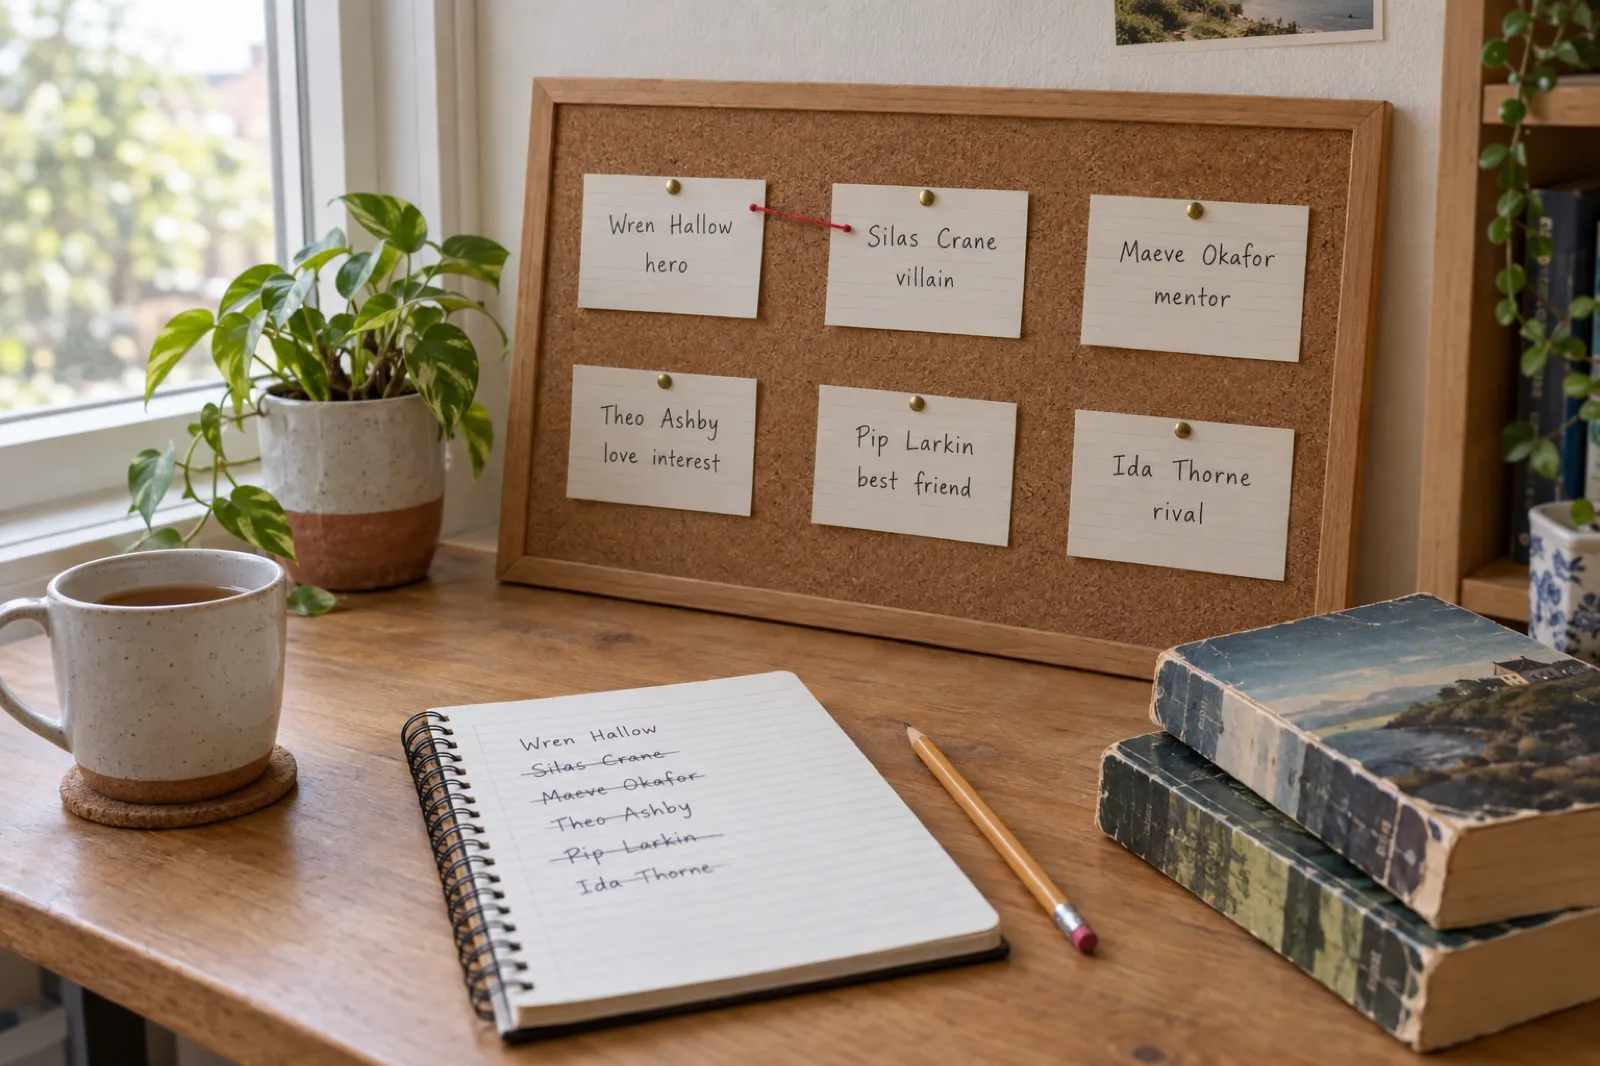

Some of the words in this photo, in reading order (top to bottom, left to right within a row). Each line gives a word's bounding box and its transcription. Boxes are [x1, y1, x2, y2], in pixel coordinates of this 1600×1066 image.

[608, 212, 655, 235] Wren
[669, 212, 733, 236] Hallow
[867, 224, 919, 248] Silas
[936, 227, 998, 251] Crane
[645, 251, 688, 274] hero
[1119, 239, 1185, 264] Maeve
[1202, 242, 1276, 269] Okafor
[896, 265, 954, 288] villain
[1154, 286, 1231, 308] mentor
[600, 403, 645, 426] Theo
[660, 407, 719, 442] Ashby
[855, 424, 889, 458] Pip
[906, 429, 974, 456] Larkin
[604, 442, 638, 464] love
[652, 449, 721, 473] interest
[1112, 454, 1153, 478] Ida
[1171, 458, 1252, 487] Thorne
[857, 465, 899, 491] best
[913, 470, 971, 499] friend
[1153, 501, 1204, 525] rival
[520, 736, 575, 752] Wren
[590, 725, 656, 742] Hallow
[531, 759, 586, 778] Silas
[601, 750, 665, 767] Crane
[541, 785, 608, 805] Maeve
[623, 771, 698, 791] Okafor
[551, 816, 606, 832] Theo
[624, 801, 692, 821] Ashby
[563, 846, 604, 865] Pip
[623, 832, 696, 854] Larkin
[577, 877, 622, 896] Ida
[635, 863, 714, 884] Thorne
